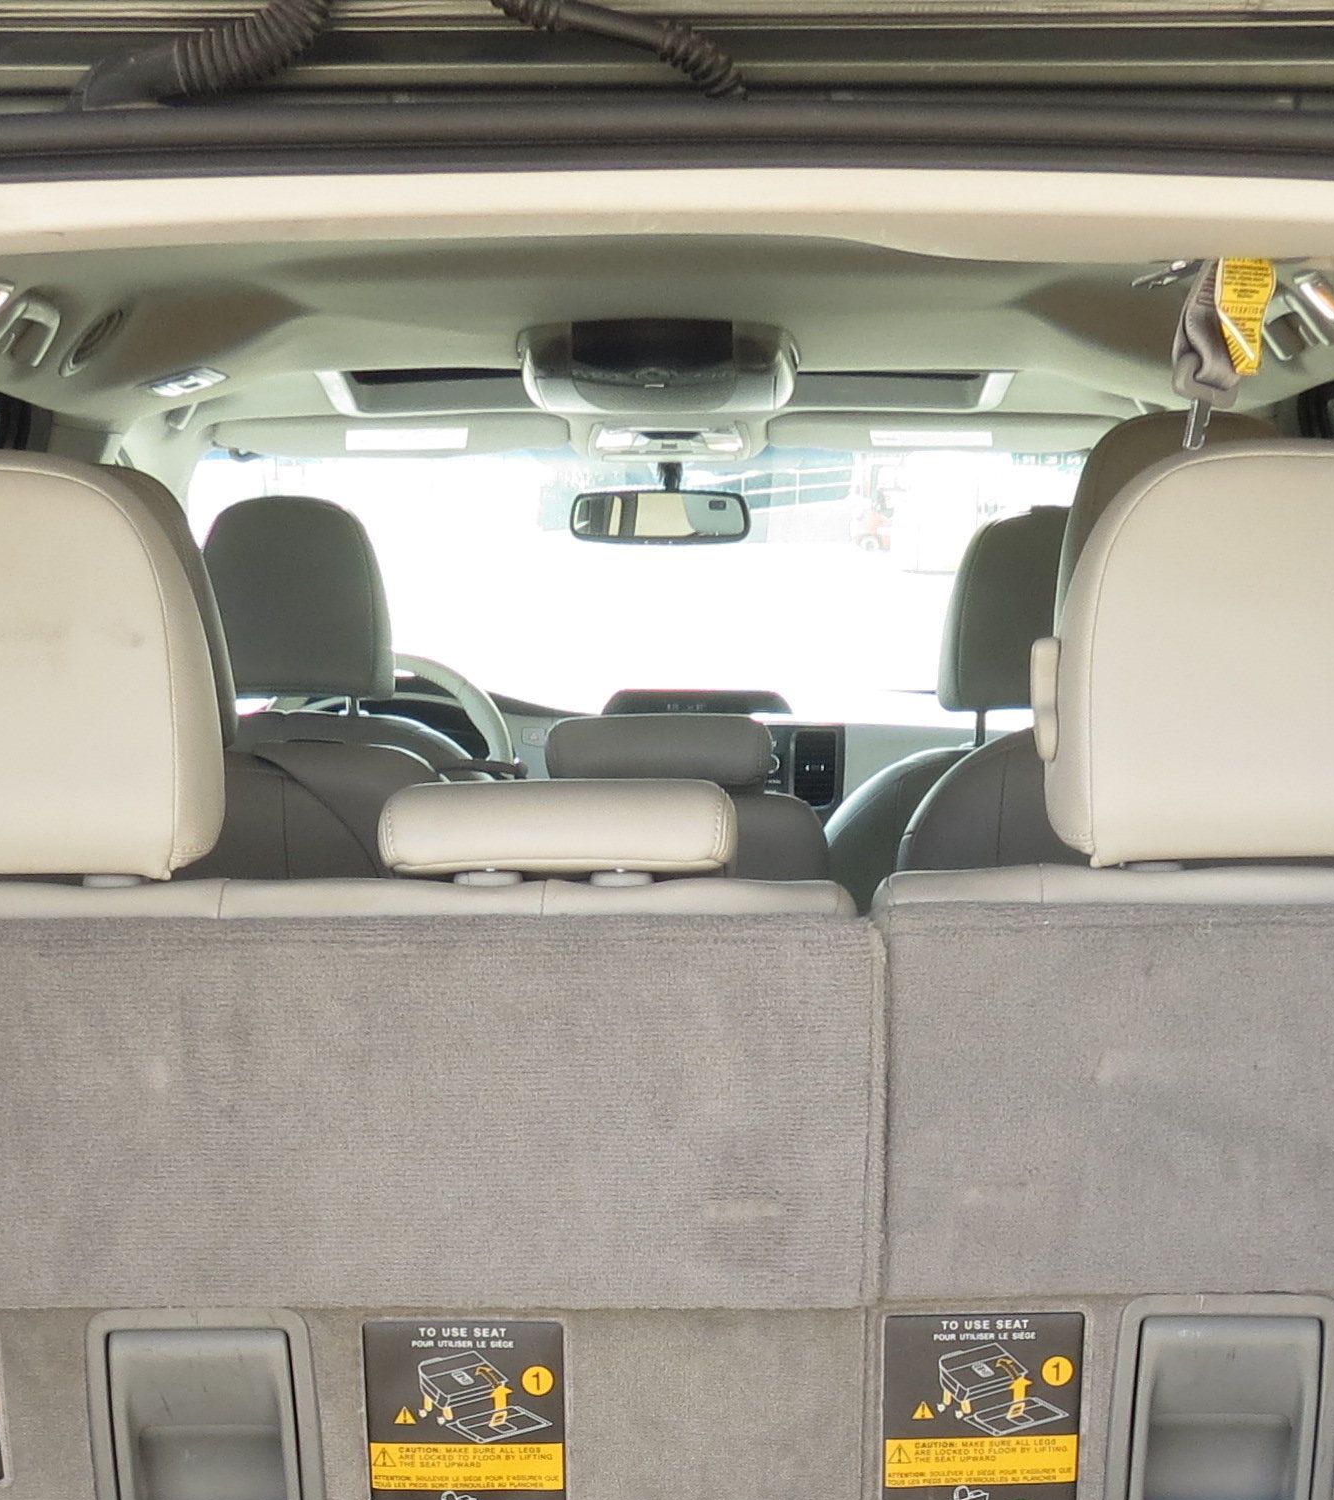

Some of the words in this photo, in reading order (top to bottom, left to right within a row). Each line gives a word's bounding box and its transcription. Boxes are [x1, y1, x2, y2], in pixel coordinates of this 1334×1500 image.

[941, 1320, 959, 1330] TO
[963, 1320, 989, 1329] USE
[995, 1319, 1029, 1329] SEAT
[419, 1327, 437, 1337] TO
[441, 1327, 467, 1337] USE
[473, 1327, 507, 1337] SEAT
[959, 1333, 995, 1341] UTILISER
[997, 1332, 1009, 1340] LE
[1051, 1362, 1060, 1381] 1
[531, 1371, 540, 1390] 1
